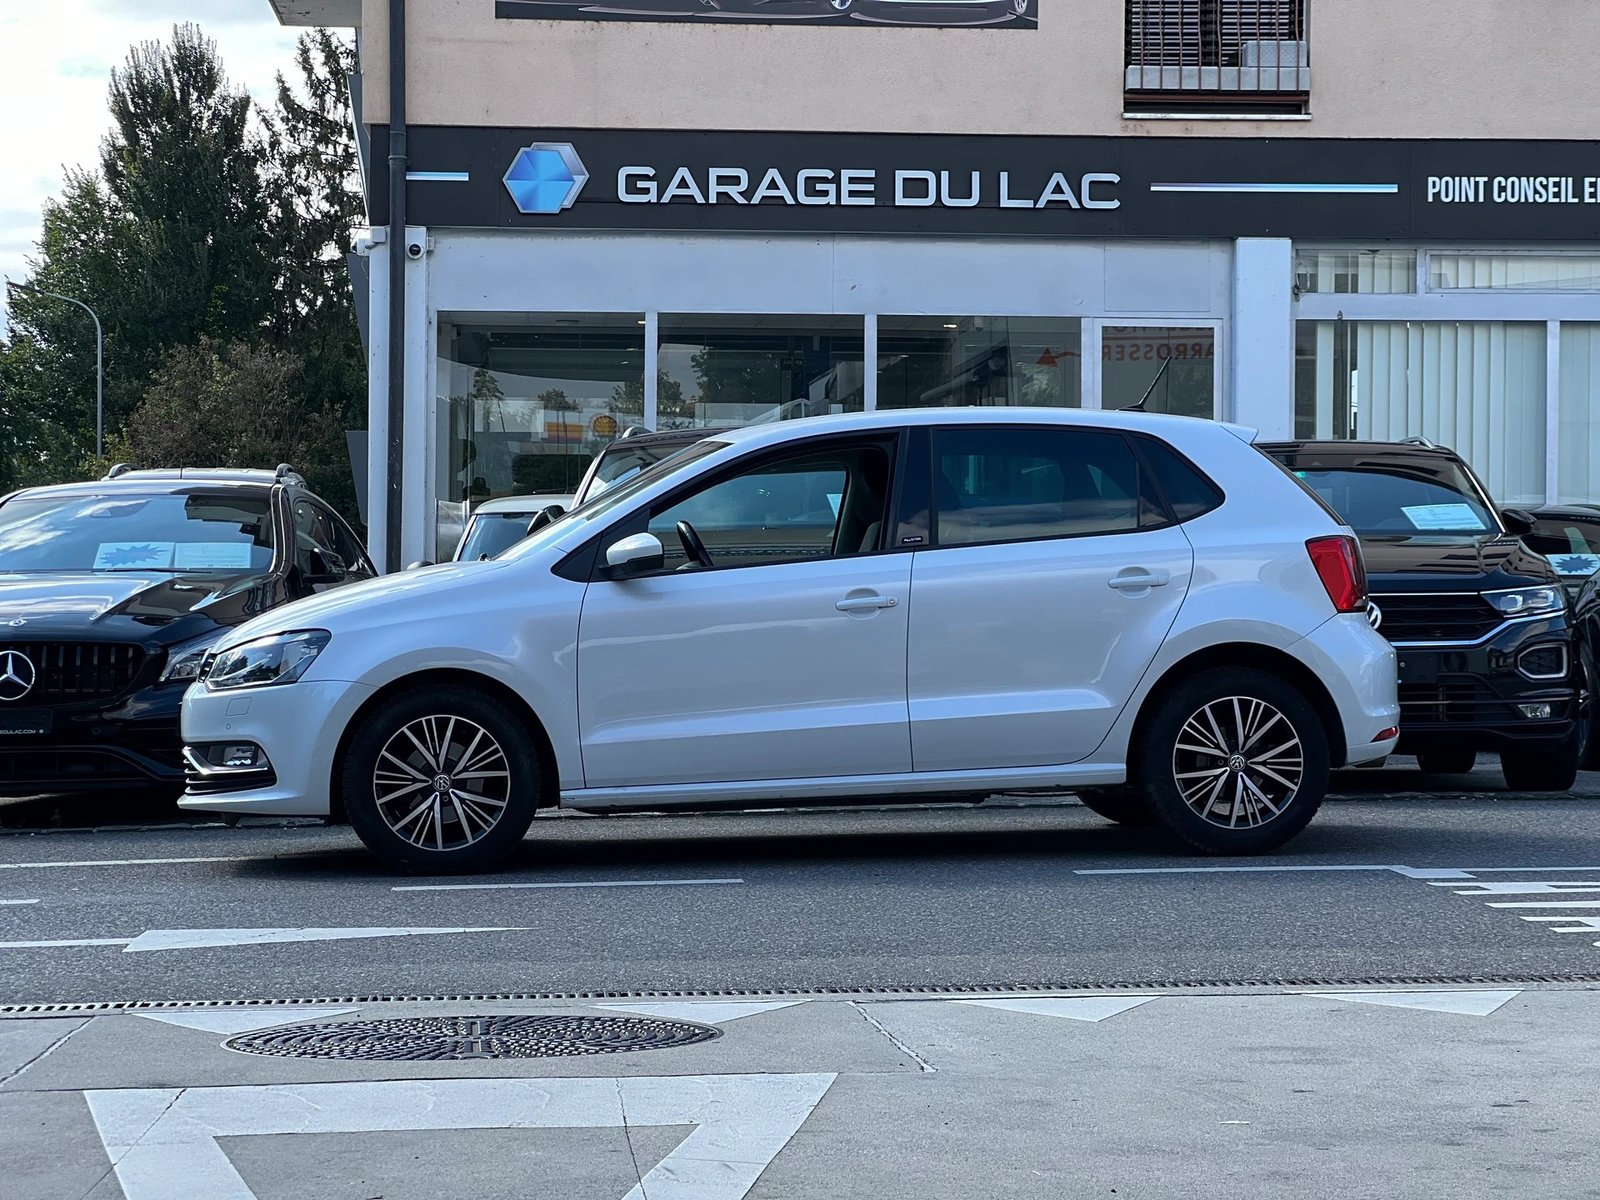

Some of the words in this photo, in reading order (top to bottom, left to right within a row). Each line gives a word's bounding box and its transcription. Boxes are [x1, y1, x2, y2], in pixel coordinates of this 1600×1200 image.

[617, 166, 876, 206] GARAGE
[894, 169, 980, 207] DU
[999, 171, 1121, 210] LAC
[1427, 176, 1489, 203] POINT
[1493, 176, 1580, 203] CONSEIL
[1584, 177, 1600, 203] E
